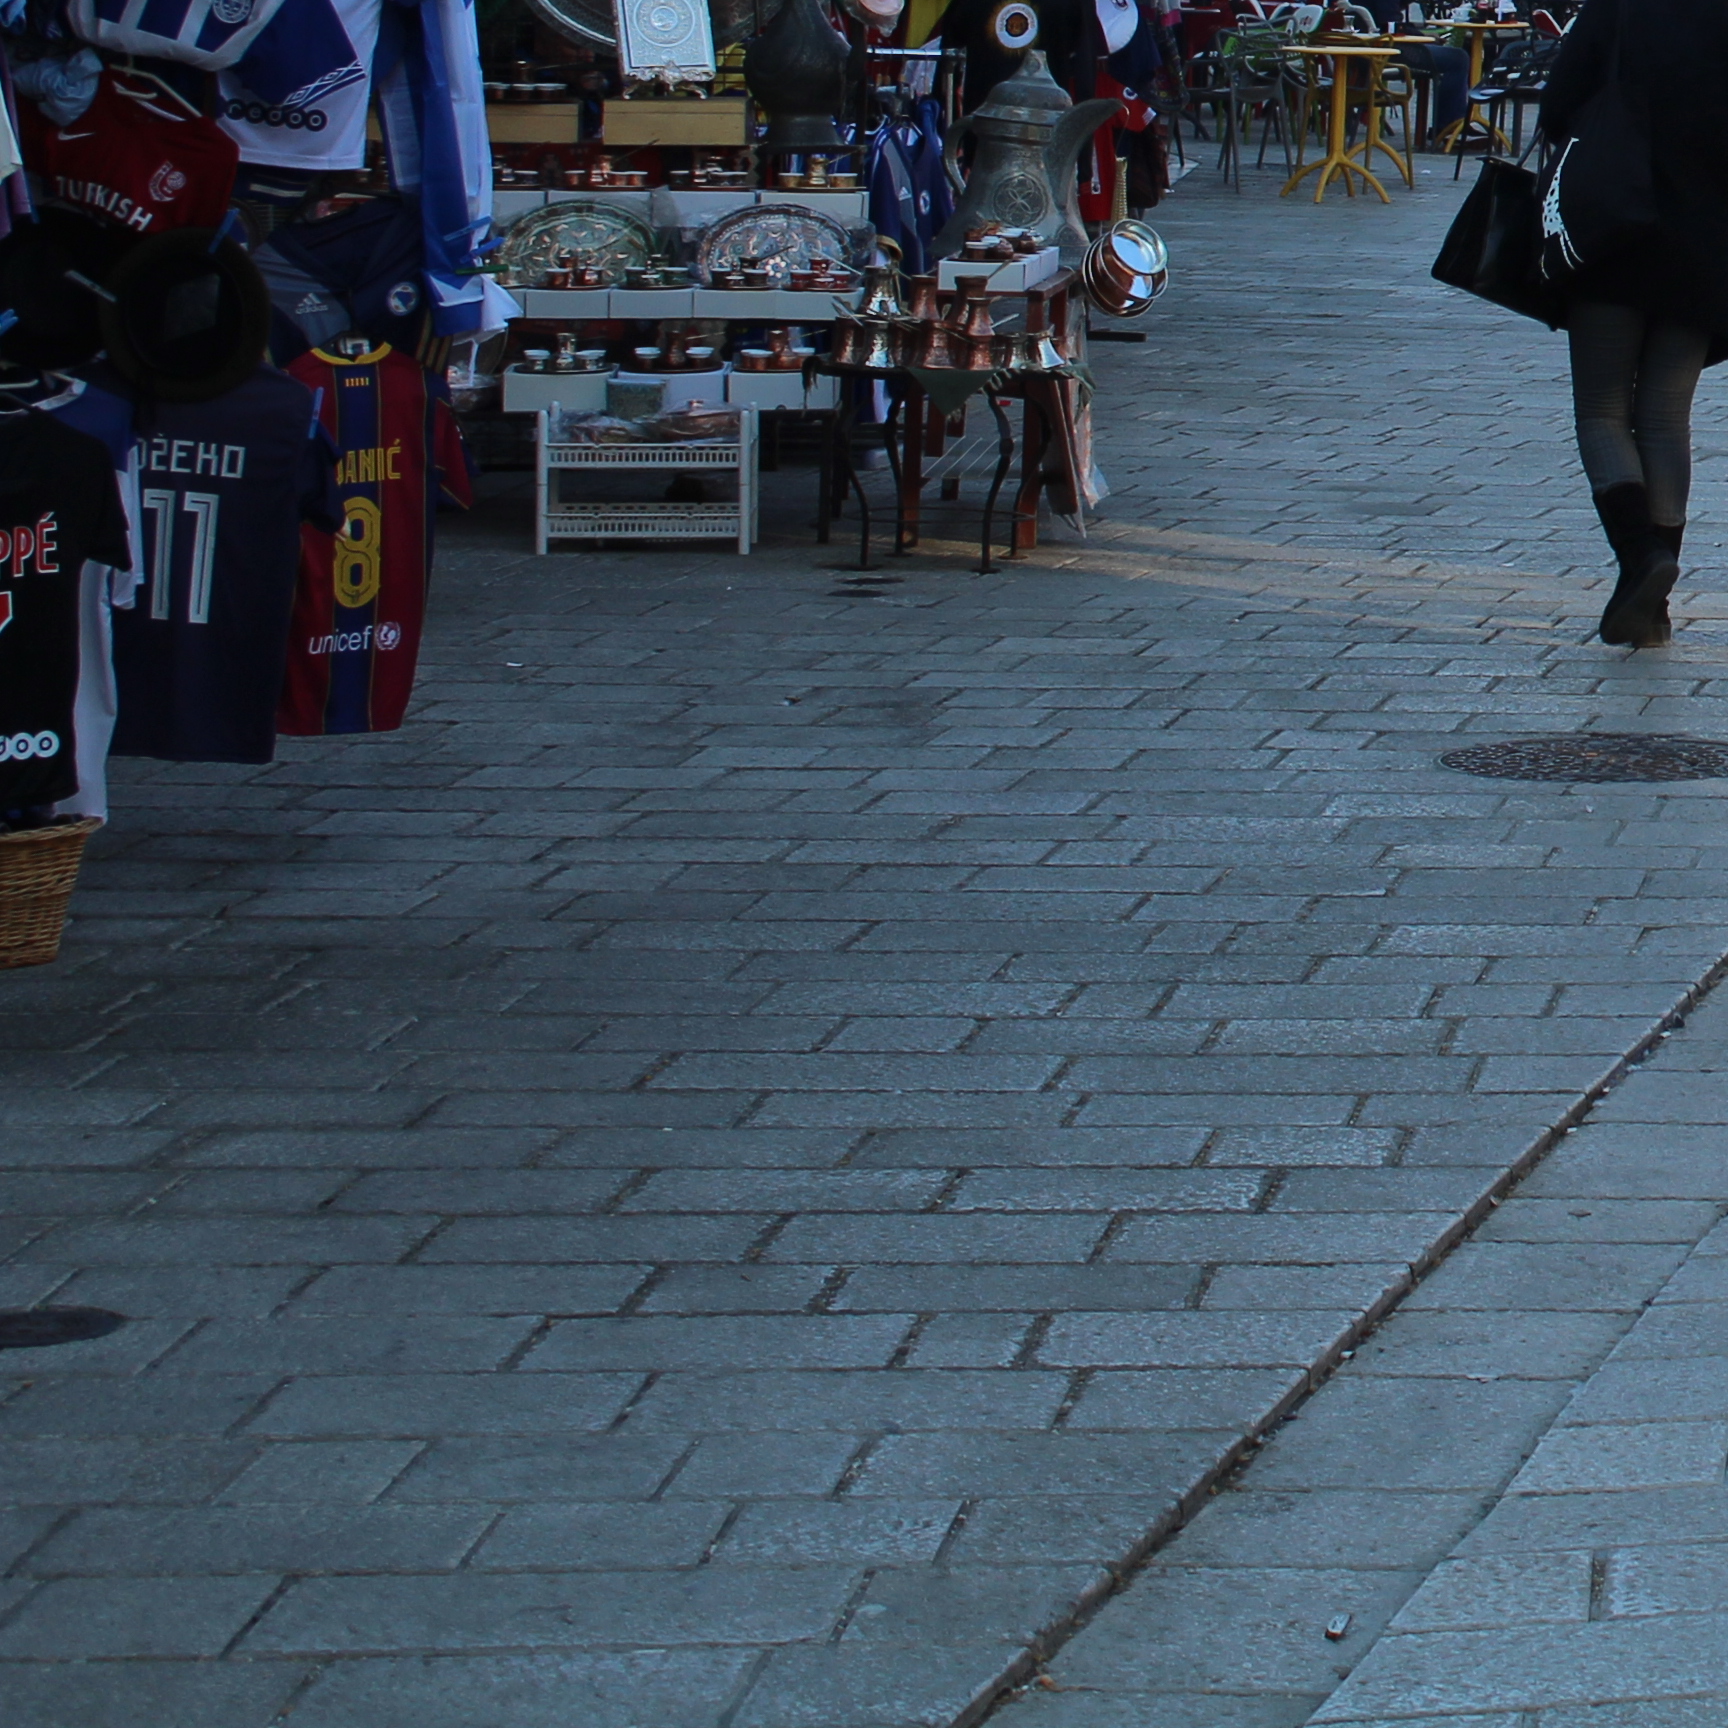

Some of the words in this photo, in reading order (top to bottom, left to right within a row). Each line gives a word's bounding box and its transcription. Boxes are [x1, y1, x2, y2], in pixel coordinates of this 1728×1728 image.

[55, 175, 154, 232] TURKISH
[142, 488, 220, 624] 11
[333, 496, 382, 609] 8
[308, 624, 373, 656] unicef
